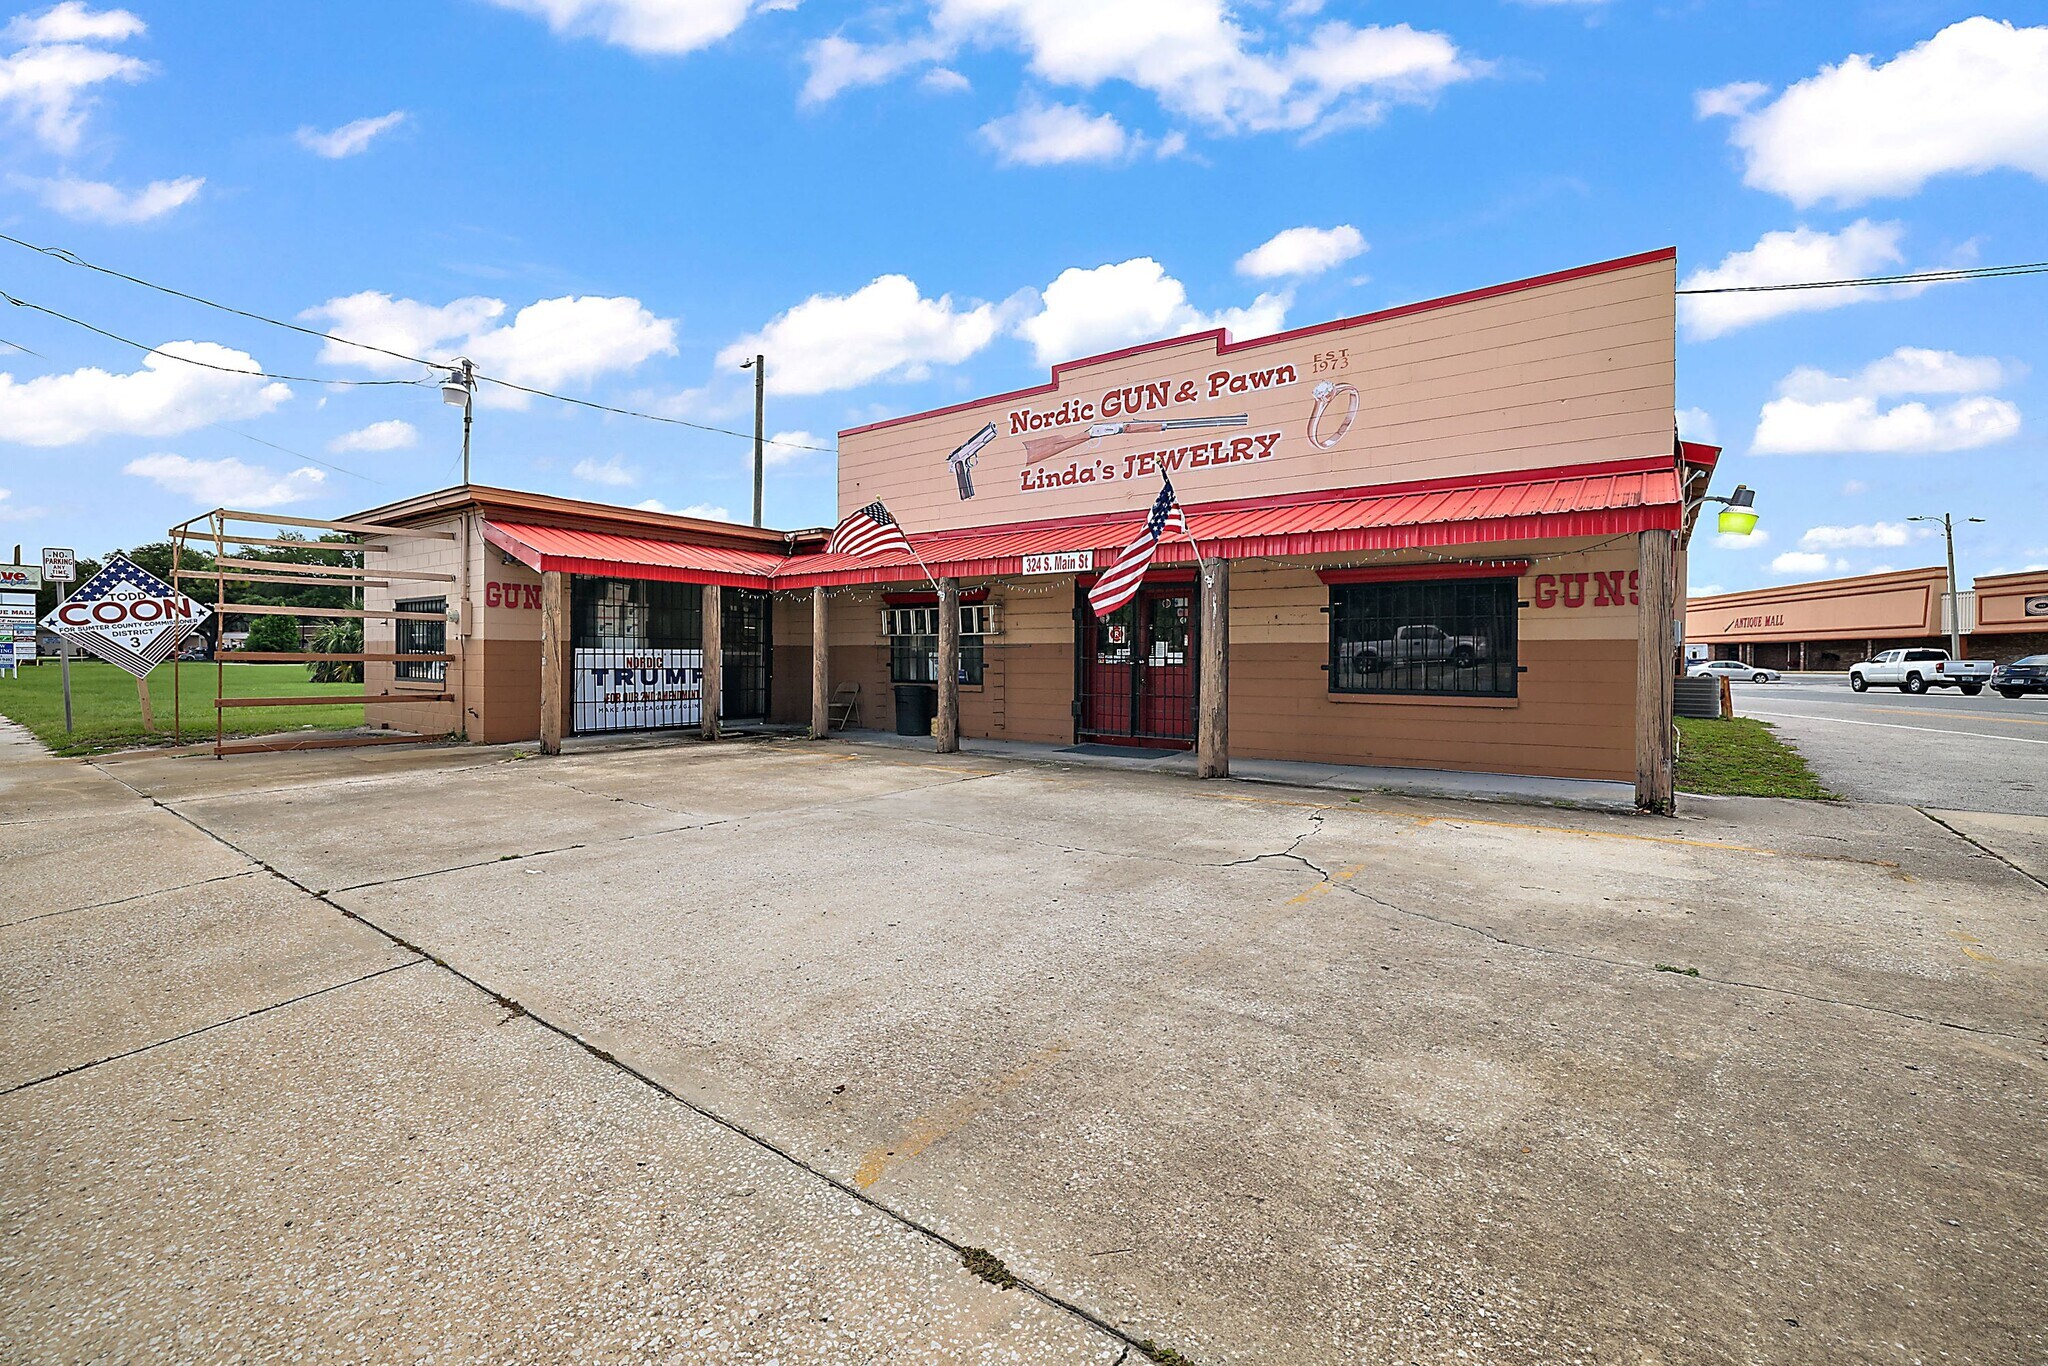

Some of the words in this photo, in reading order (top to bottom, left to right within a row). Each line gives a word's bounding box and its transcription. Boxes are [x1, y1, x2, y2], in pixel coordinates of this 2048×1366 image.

[1312, 357, 1349, 374] 1973
[1009, 399, 1095, 435] Nordic
[1100, 380, 1171, 418] GUN
[1174, 380, 1198, 402] &
[1208, 364, 1297, 398] Pawn
[1020, 459, 1115, 491] Linda's
[1122, 432, 1281, 479] JEWELRY
[45, 557, 73, 566] PARKING
[52, 551, 65, 559] NO
[1026, 556, 1042, 573] 324
[1043, 556, 1053, 571] S.
[1054, 554, 1076, 571] Main
[1078, 553, 1089, 569] St
[107, 592, 147, 602] TODD
[58, 597, 192, 626] COON
[77, 624, 110, 632] SUMTER
[111, 622, 143, 630] COUNTY
[1734, 616, 1762, 629] ANTIQUE
[1764, 614, 1785, 627] MALL
[112, 628, 154, 638] DISTRICT
[129, 637, 141, 648] 3
[626, 656, 664, 669] NORDIC
[591, 667, 703, 687] TRUMP
